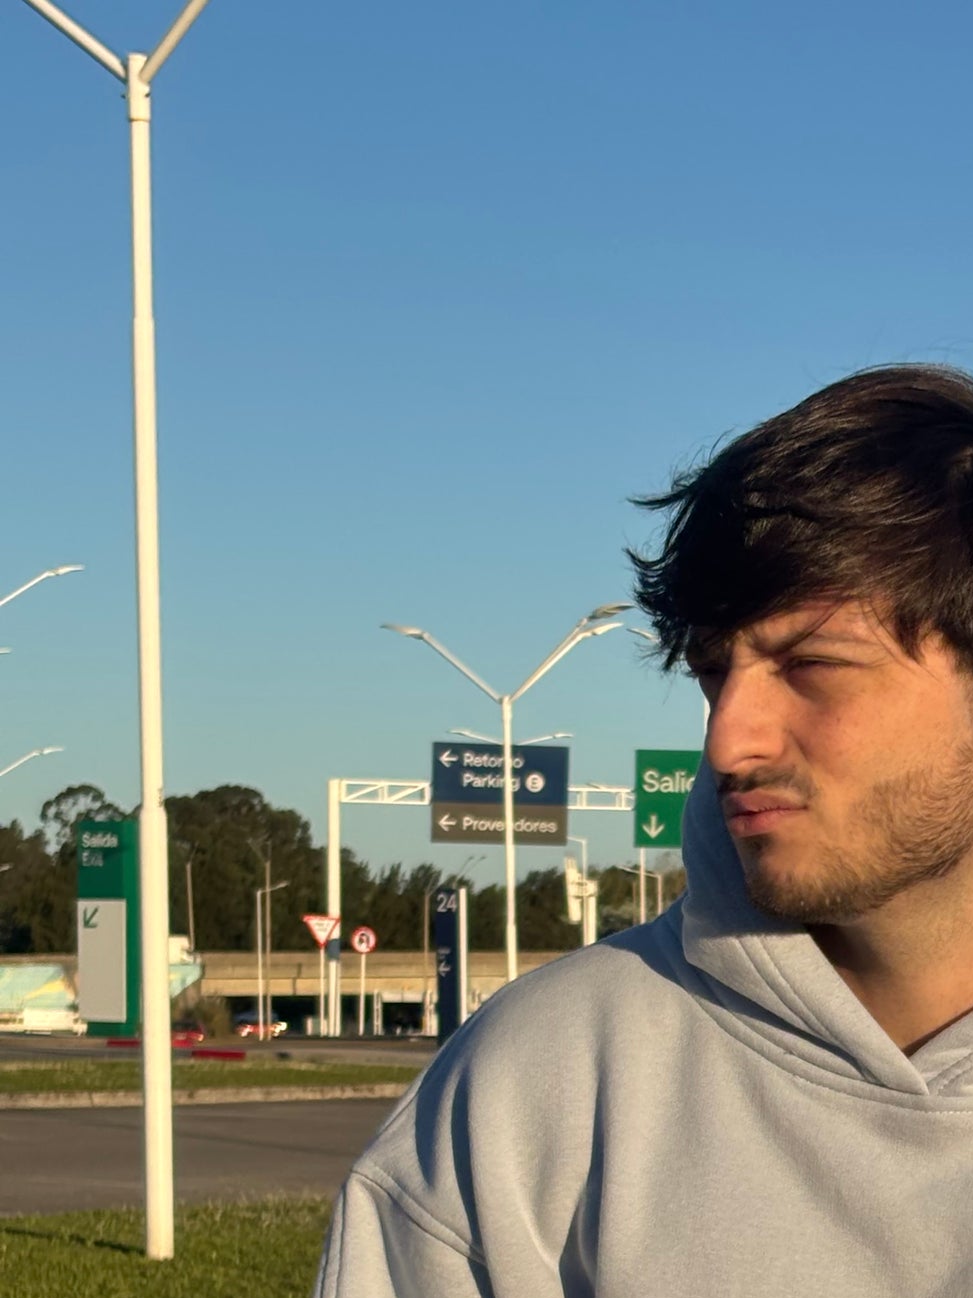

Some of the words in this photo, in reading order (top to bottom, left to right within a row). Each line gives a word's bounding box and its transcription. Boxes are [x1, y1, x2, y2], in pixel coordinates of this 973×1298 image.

[462, 752, 524, 769] Retoro
[462, 816, 558, 833] Provedores
[437, 894, 457, 912] 24
